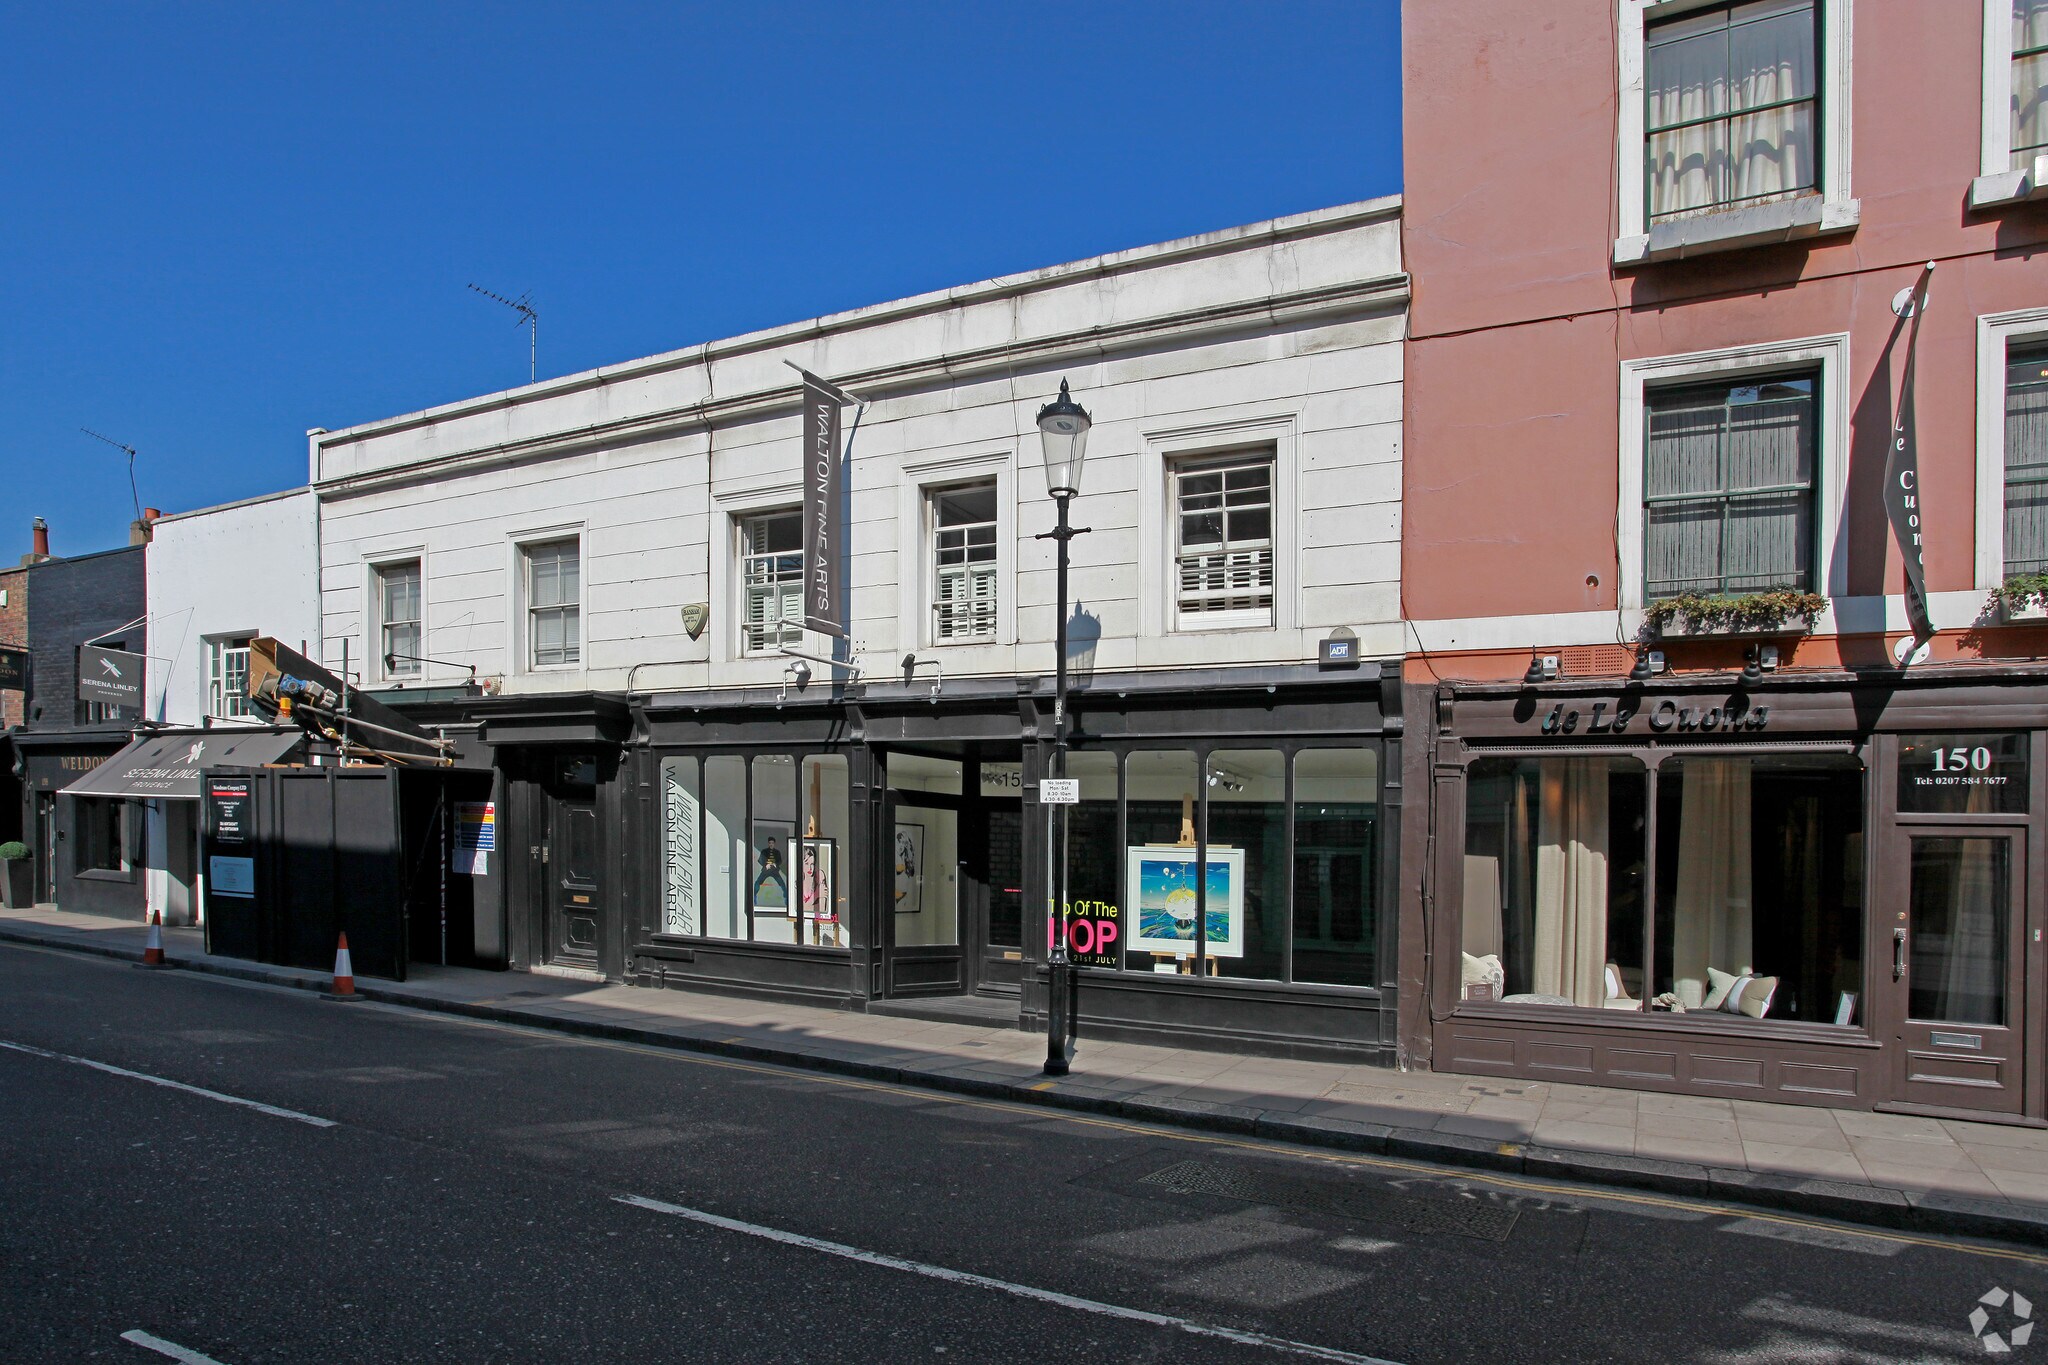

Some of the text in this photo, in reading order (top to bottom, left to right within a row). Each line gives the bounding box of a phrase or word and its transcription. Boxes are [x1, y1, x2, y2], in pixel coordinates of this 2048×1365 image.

[816, 404, 830, 611] WALTON FINE ARTS
[1331, 646, 1347, 655] ADT
[82, 678, 138, 692] SERENA LINLEY
[1541, 699, 1770, 733] de Le Cuona
[61, 756, 109, 771] WELDON
[1931, 746, 1991, 772] 150
[123, 768, 200, 780] SERENA LINLE
[1003, 772, 1023, 788] 15
[1914, 776, 2007, 785] Tel: 0207 584 7677
[665, 765, 678, 926] WALTON FINE ARTS
[1074, 900, 1091, 916] Of
[1093, 901, 1118, 918] The
[1073, 954, 1117, 965] 21st JULY
